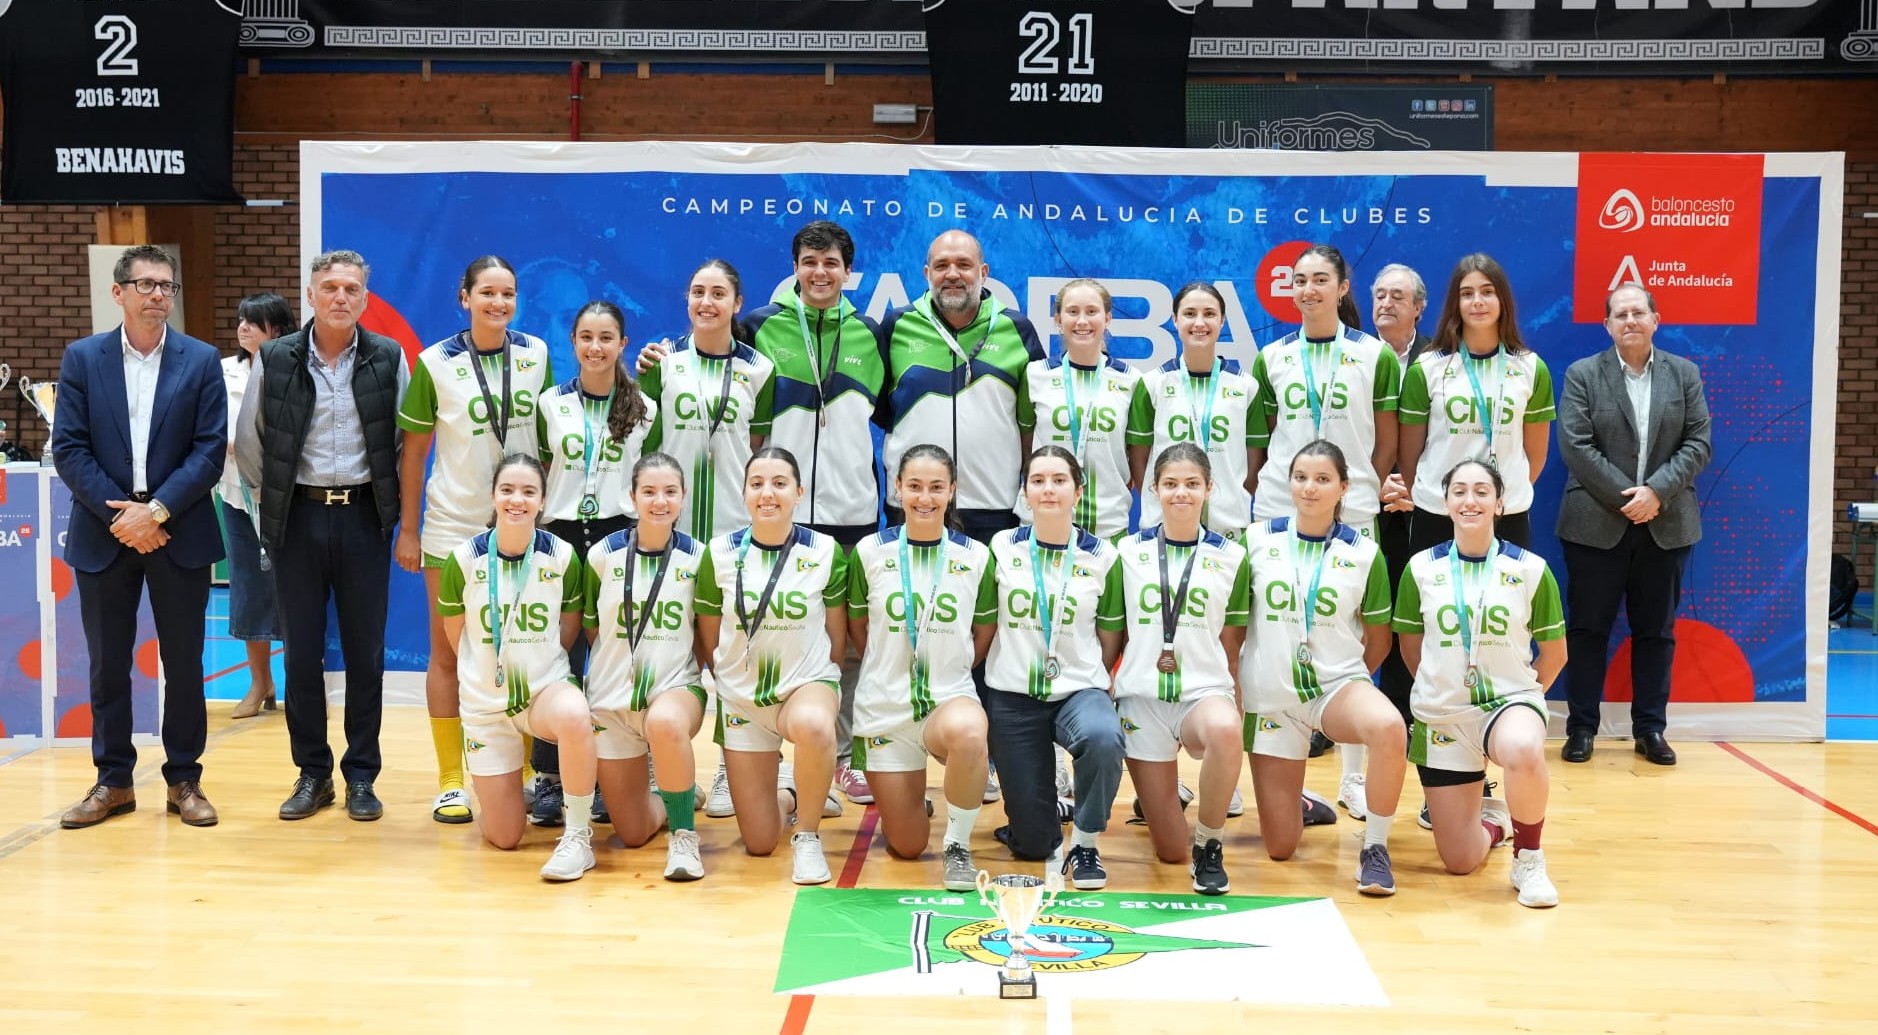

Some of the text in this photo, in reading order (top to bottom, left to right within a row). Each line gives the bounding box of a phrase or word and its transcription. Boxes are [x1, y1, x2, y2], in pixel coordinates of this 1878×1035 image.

[94, 14, 138, 76] 2
[1018, 11, 1095, 75] 21
[1217, 120, 1375, 148] Uniformes
[55, 147, 186, 175] BENAHAVIS
[662, 197, 1431, 224] CAMPEONATO DE ANDALUCIA DE CLUBES
[1651, 196, 1735, 212] baloncesto
[1648, 260, 1686, 272] Junta
[1648, 273, 1733, 287] de Andalucía
[898, 896, 965, 906] CLUB
[1120, 900, 1228, 911] SEVILLA
